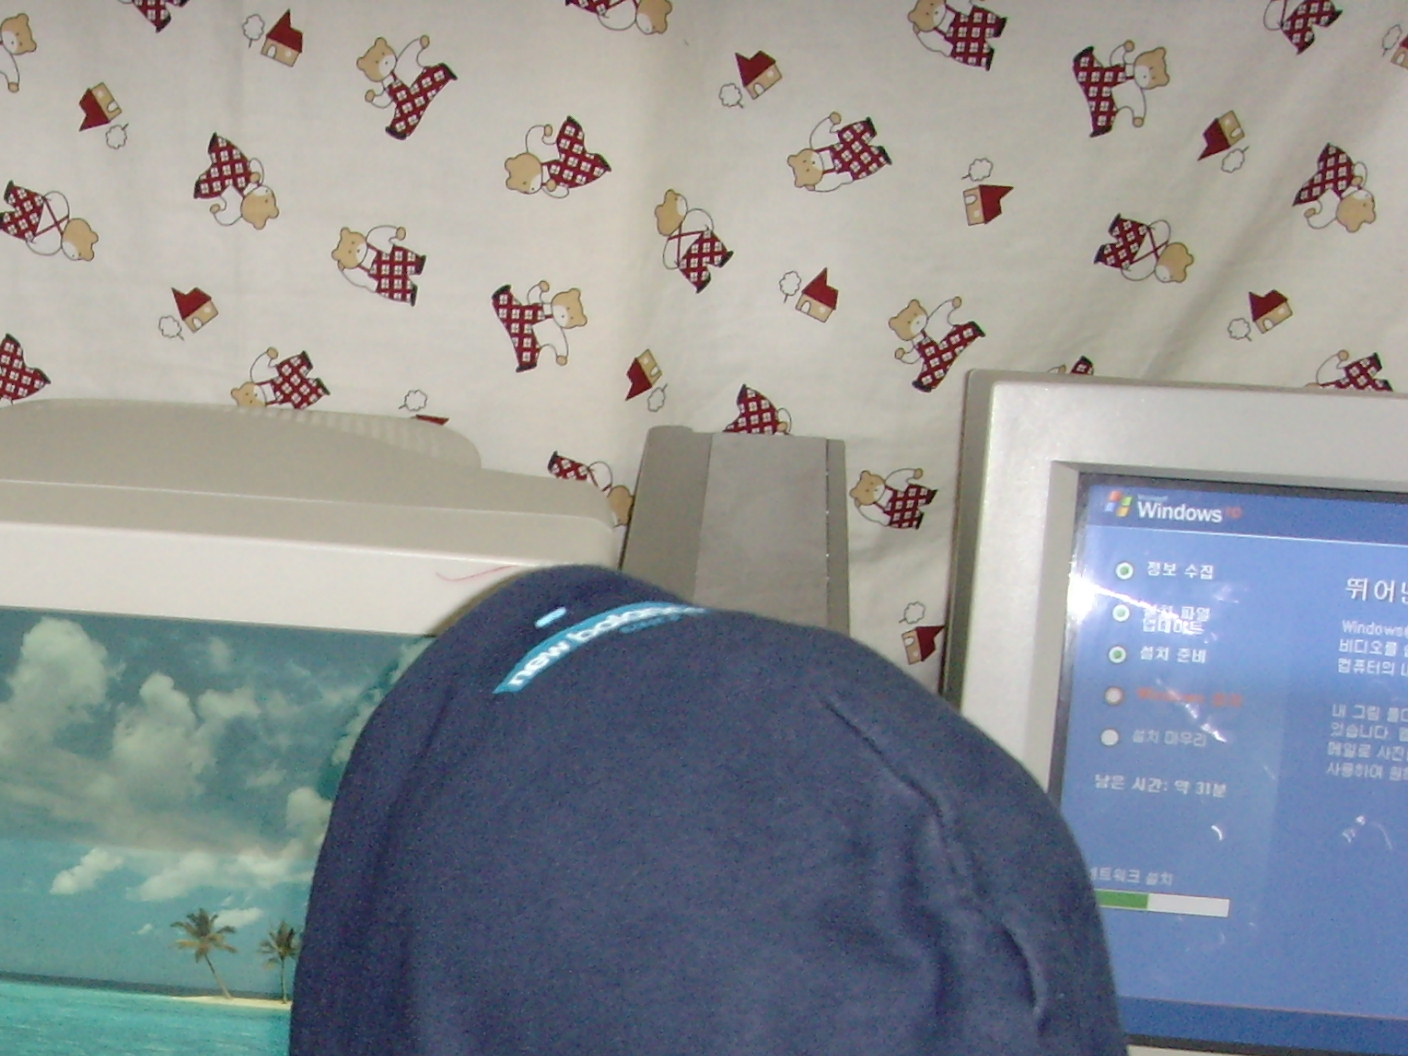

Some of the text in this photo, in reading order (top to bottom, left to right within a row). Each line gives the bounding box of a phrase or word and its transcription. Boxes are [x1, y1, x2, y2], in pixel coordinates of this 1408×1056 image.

[1137, 501, 1223, 523] Windows
[1147, 560, 1177, 577] 정보
[506, 639, 571, 686] new
[1377, 745, 1408, 762] 사진
